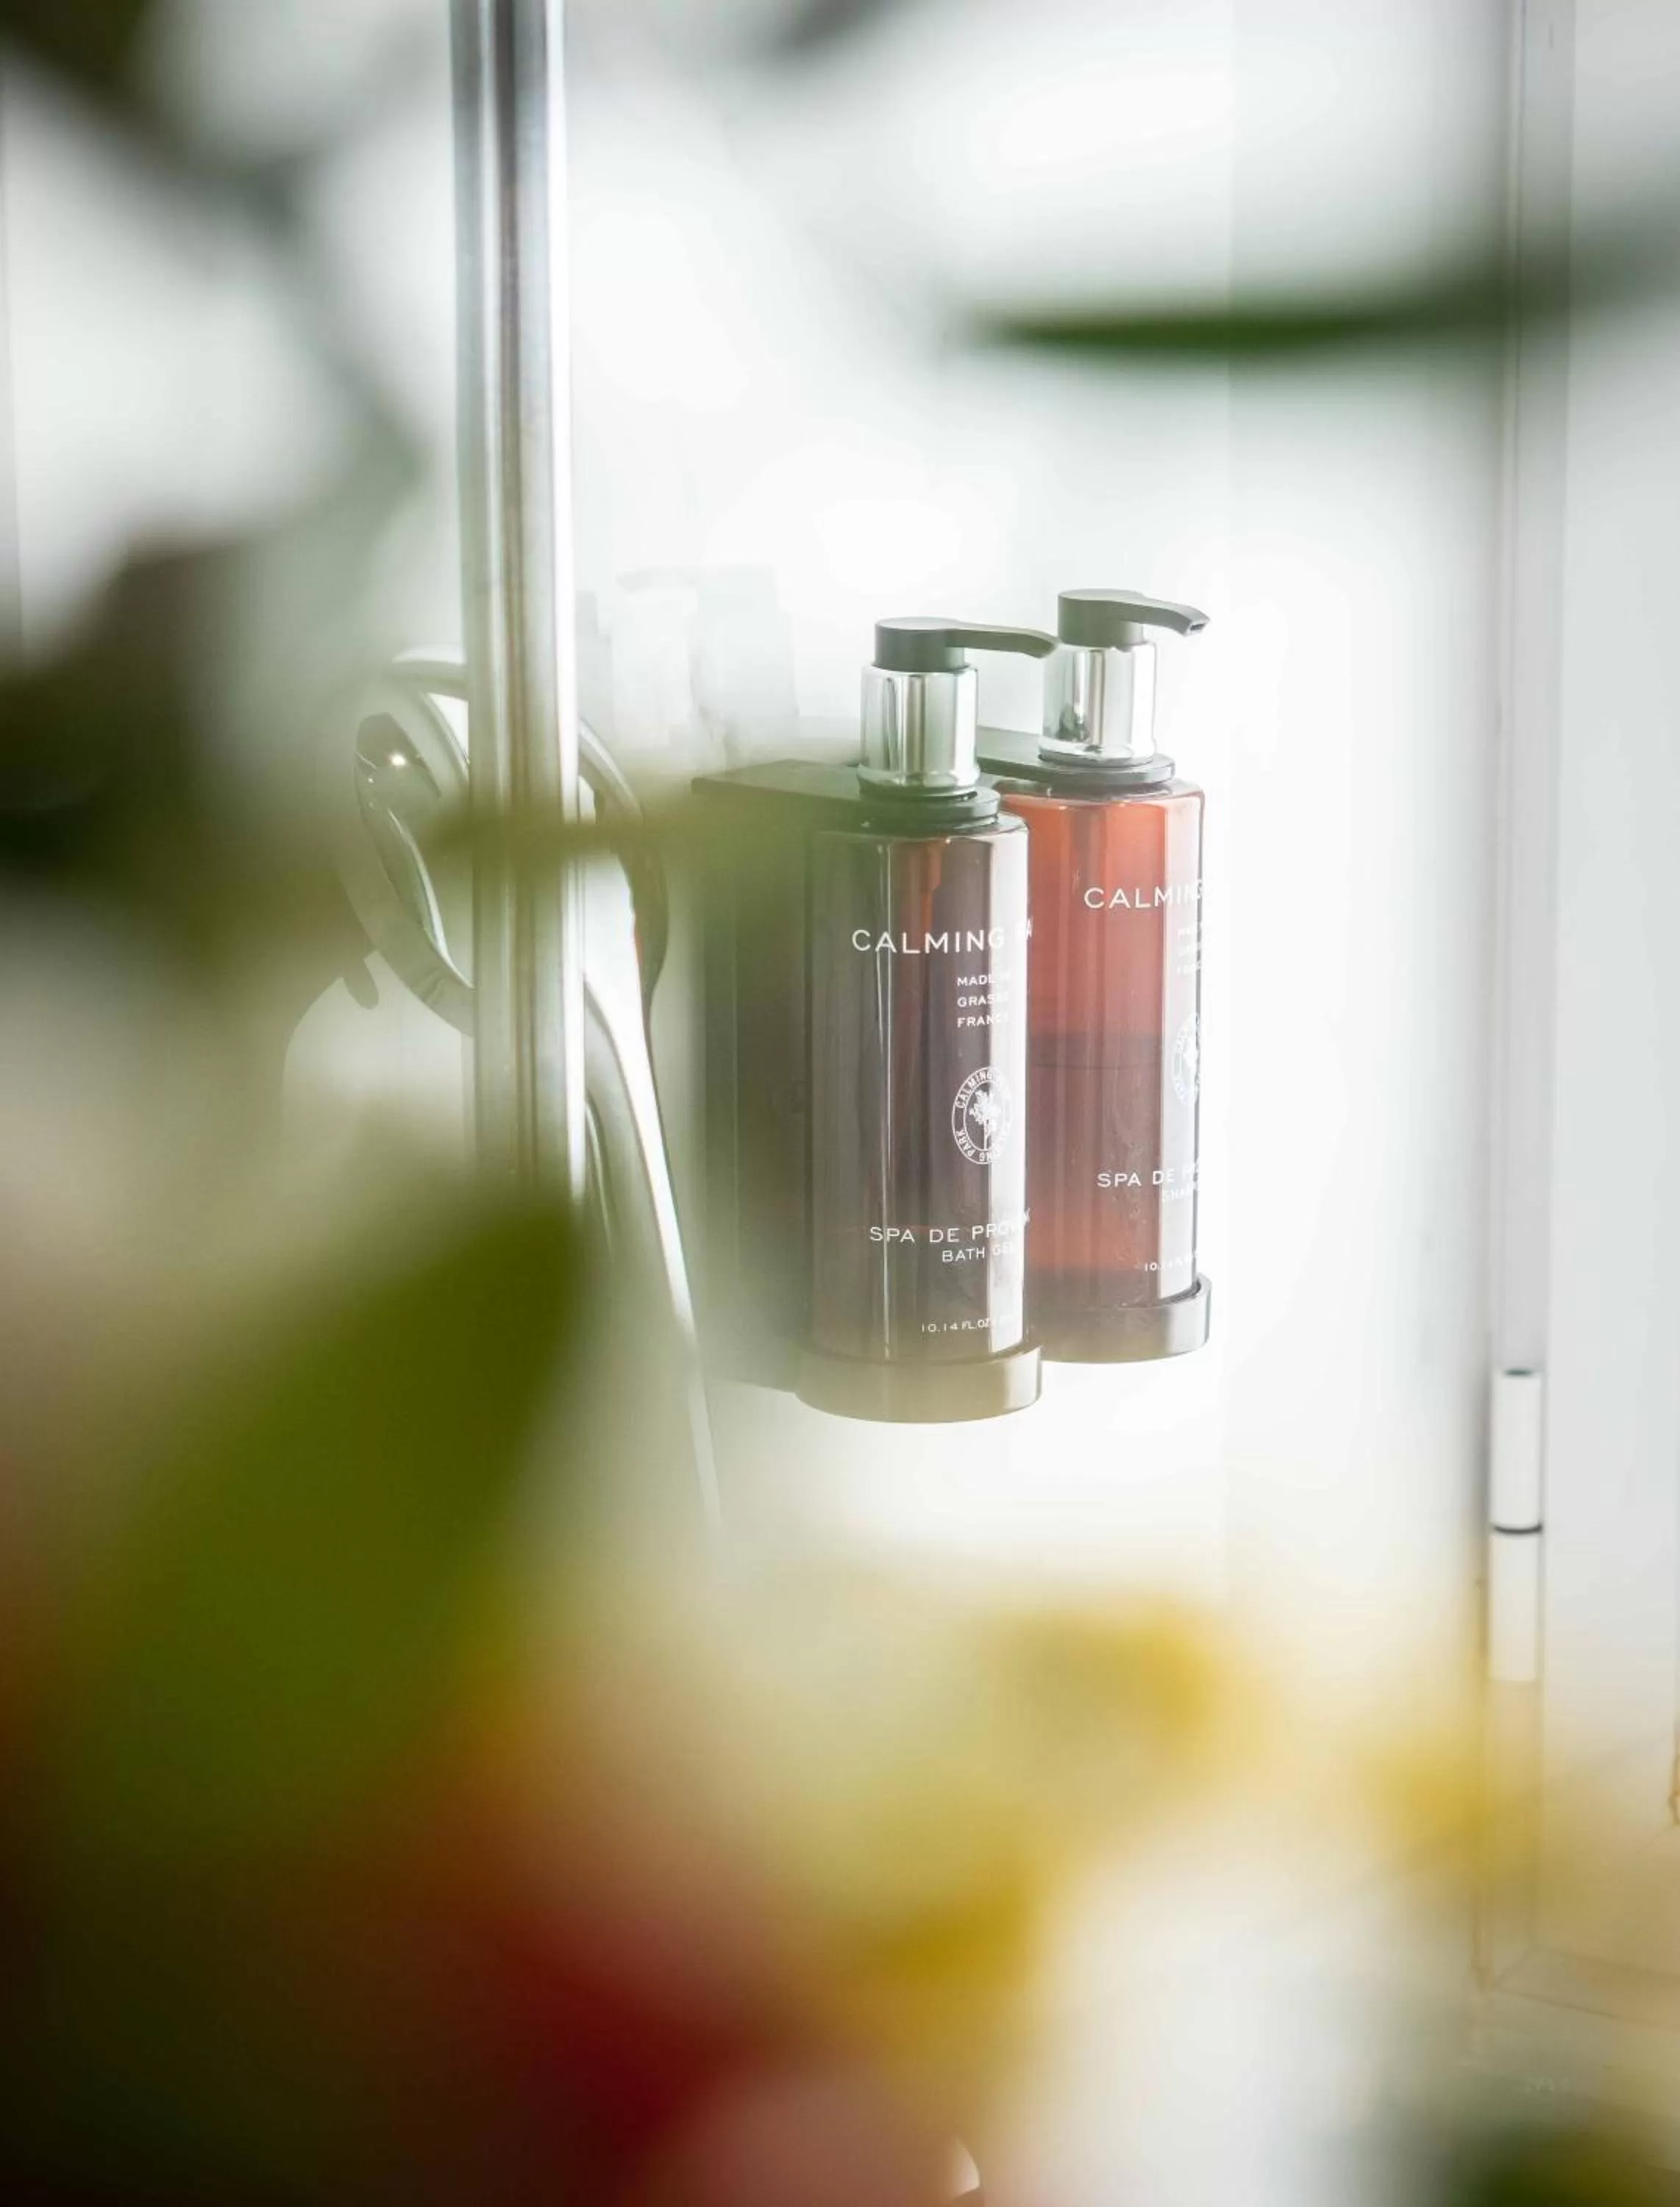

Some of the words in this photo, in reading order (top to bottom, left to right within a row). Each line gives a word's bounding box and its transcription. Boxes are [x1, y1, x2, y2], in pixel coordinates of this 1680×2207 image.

[853, 928, 1005, 954] CALMING
[957, 992, 1009, 1007] GRAS
[955, 1071, 993, 1108] CALMING
[956, 1129, 975, 1157] PARK
[1097, 1172, 1142, 1187] SPA
[1153, 1168, 1175, 1185] DE
[870, 1226, 915, 1243] SPA
[929, 1228, 960, 1243] DE
[942, 1246, 986, 1262] BATH
